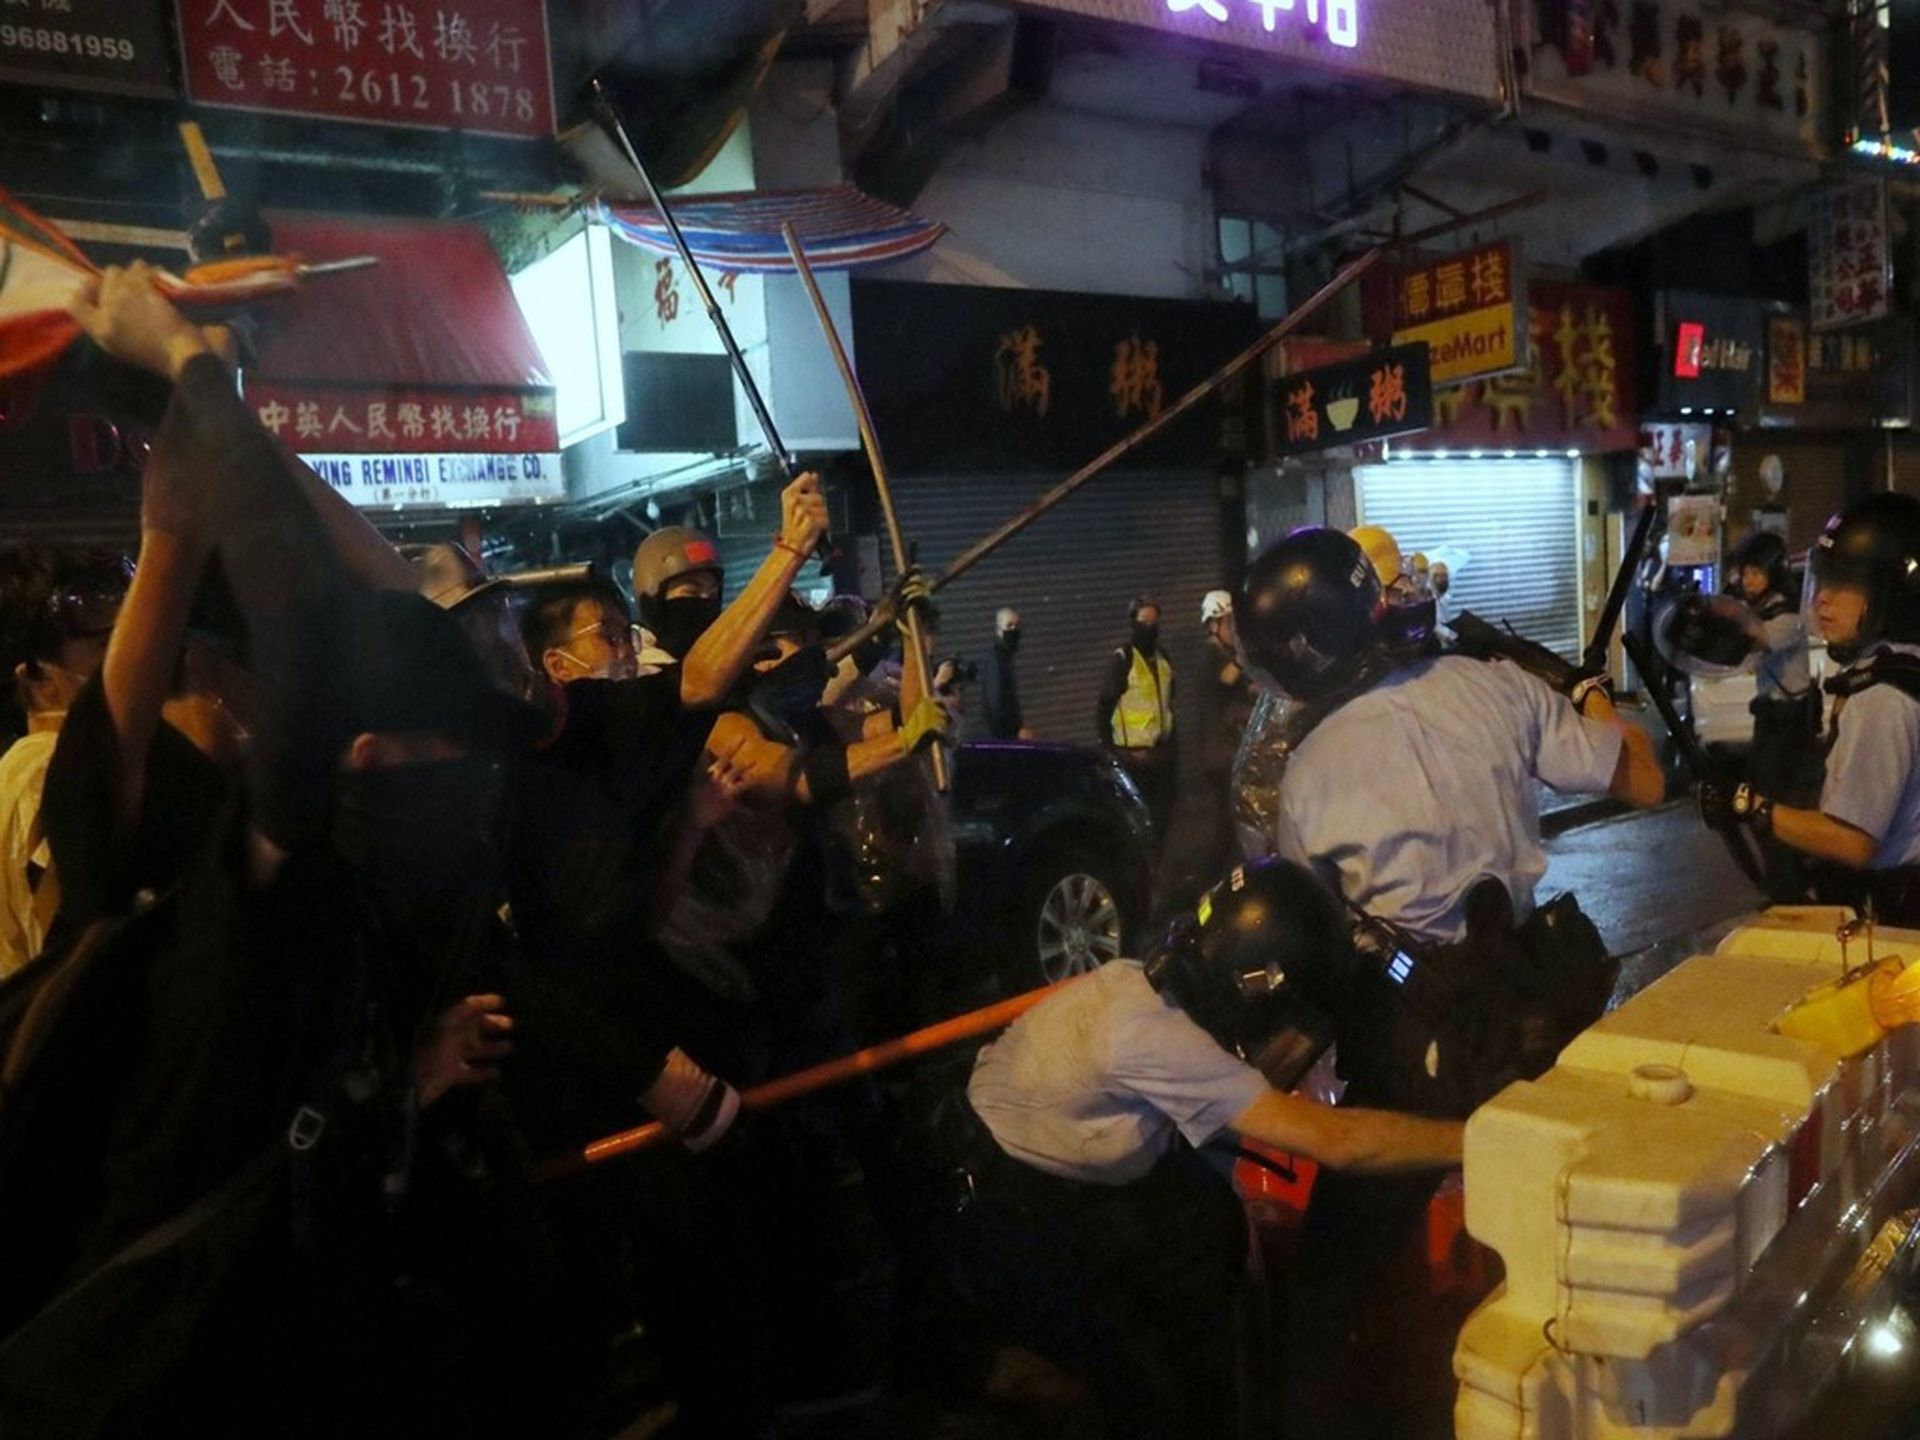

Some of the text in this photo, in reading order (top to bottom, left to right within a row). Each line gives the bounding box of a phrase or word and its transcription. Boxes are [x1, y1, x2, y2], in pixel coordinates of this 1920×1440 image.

[0, 25, 135, 61] 96881959
[336, 66, 429, 110] 2612
[451, 79, 535, 122] 1878
[259, 401, 521, 441] 中英人民幣找換行
[362, 458, 430, 486] REMINBI
[522, 453, 547, 480] CO.
